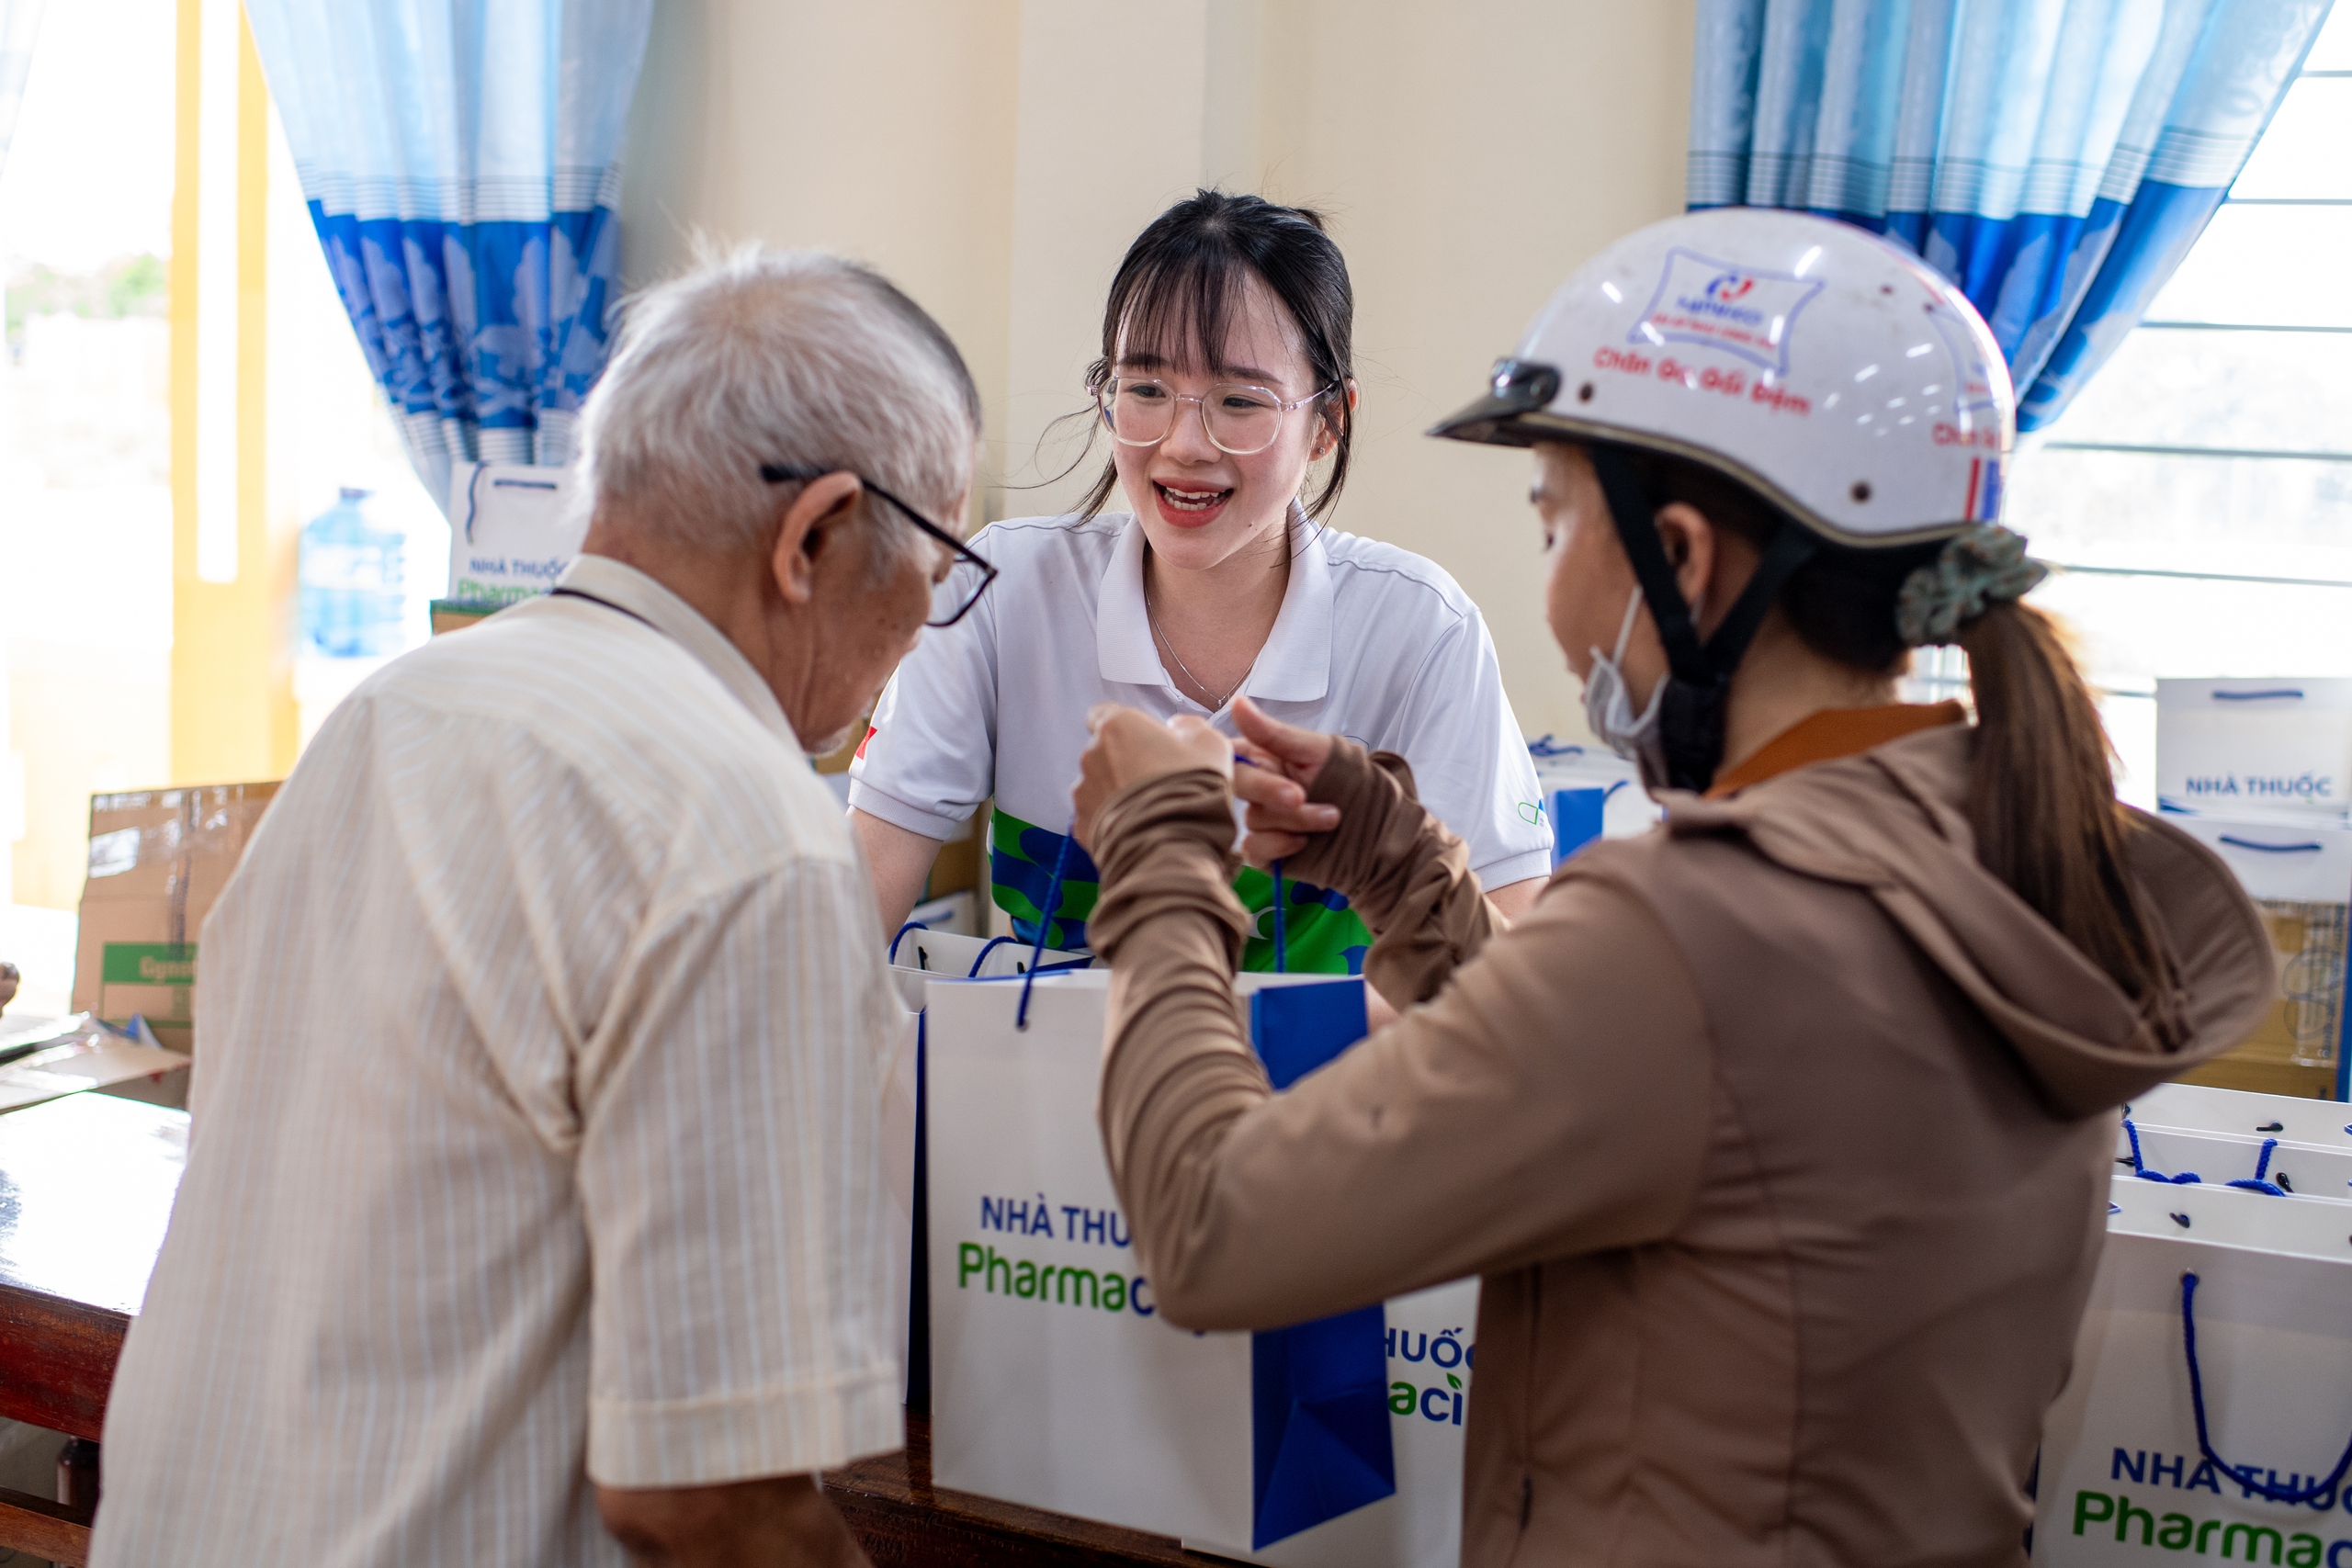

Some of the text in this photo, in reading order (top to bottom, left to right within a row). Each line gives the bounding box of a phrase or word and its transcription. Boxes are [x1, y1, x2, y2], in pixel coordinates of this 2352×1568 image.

[458, 579, 552, 603] Pharma
[2187, 771, 2333, 797] NHÀ THUỐC
[981, 1192, 1132, 1248] NHÀ THU
[958, 1242, 1156, 1317] Pharmac
[2233, 1463, 2352, 1517] THU
